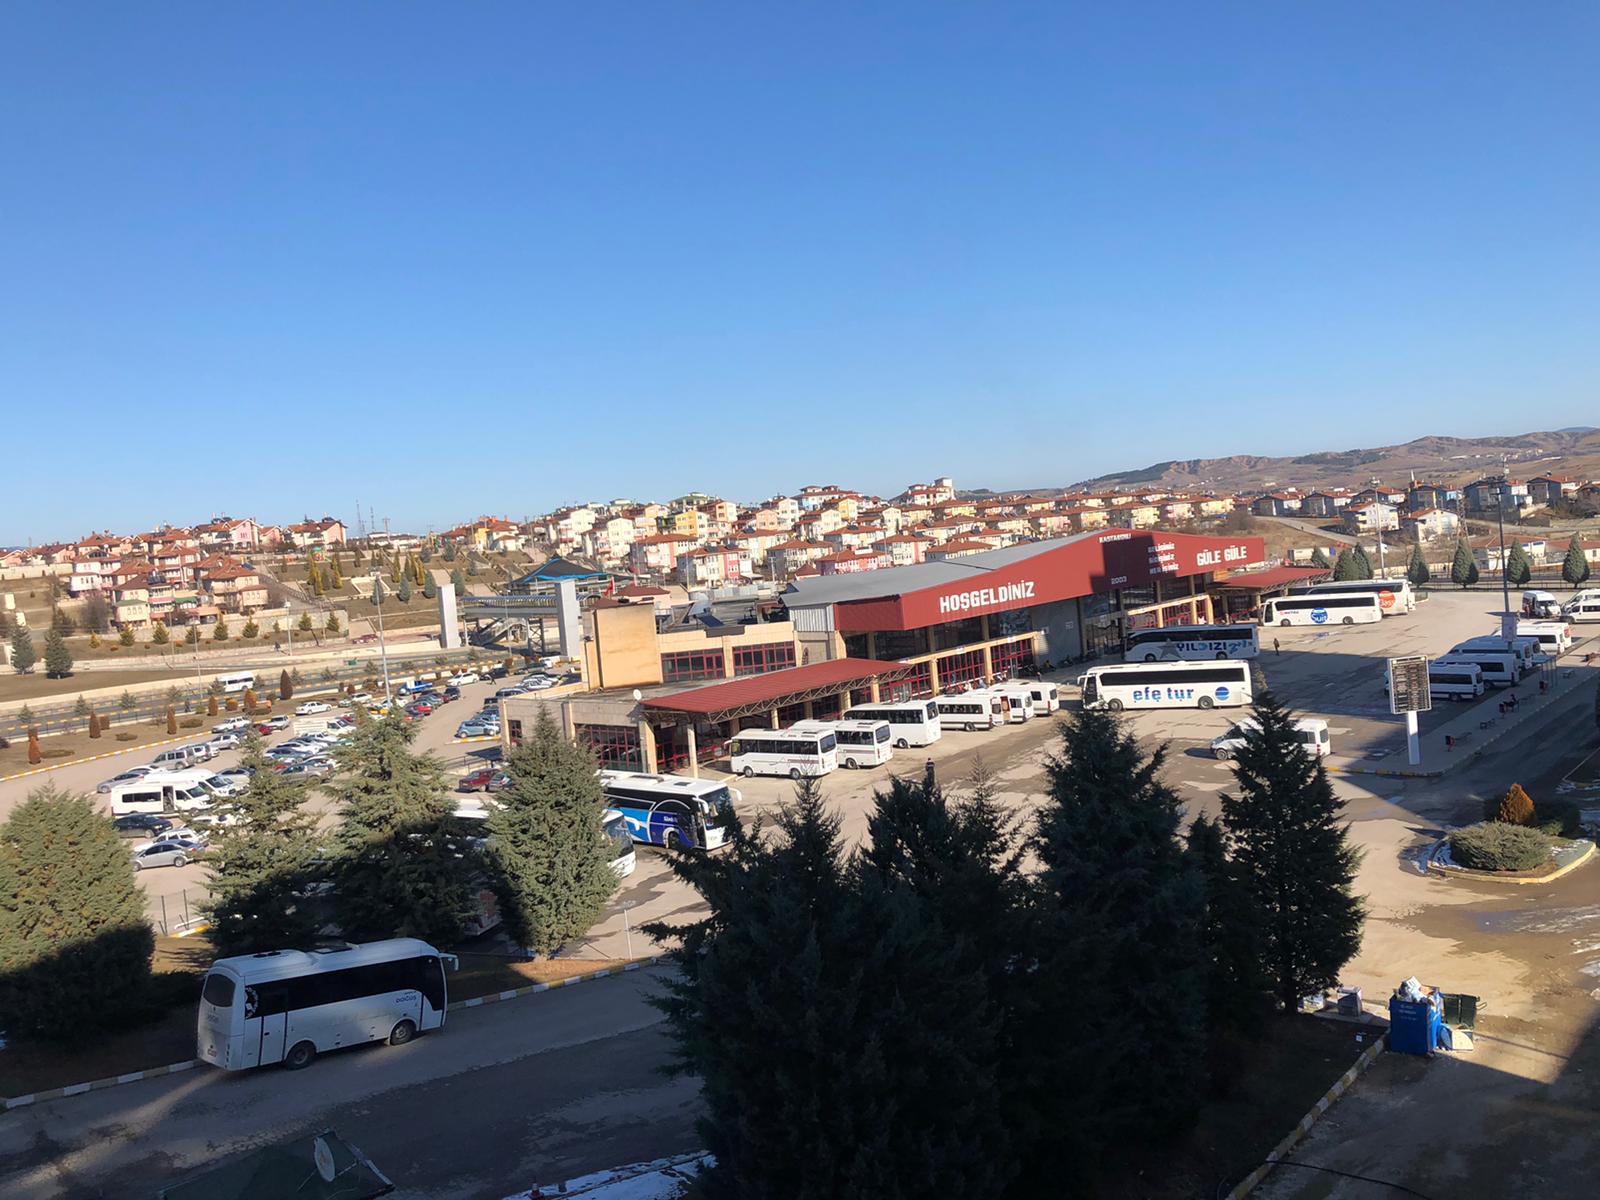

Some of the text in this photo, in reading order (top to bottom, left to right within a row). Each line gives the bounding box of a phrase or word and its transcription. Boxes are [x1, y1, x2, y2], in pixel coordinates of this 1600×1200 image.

[1196, 545, 1247, 567] GÜLE GÜLE
[940, 580, 1035, 613] HOŞGELDİNİZ
[1133, 687, 1194, 701] efe tur
